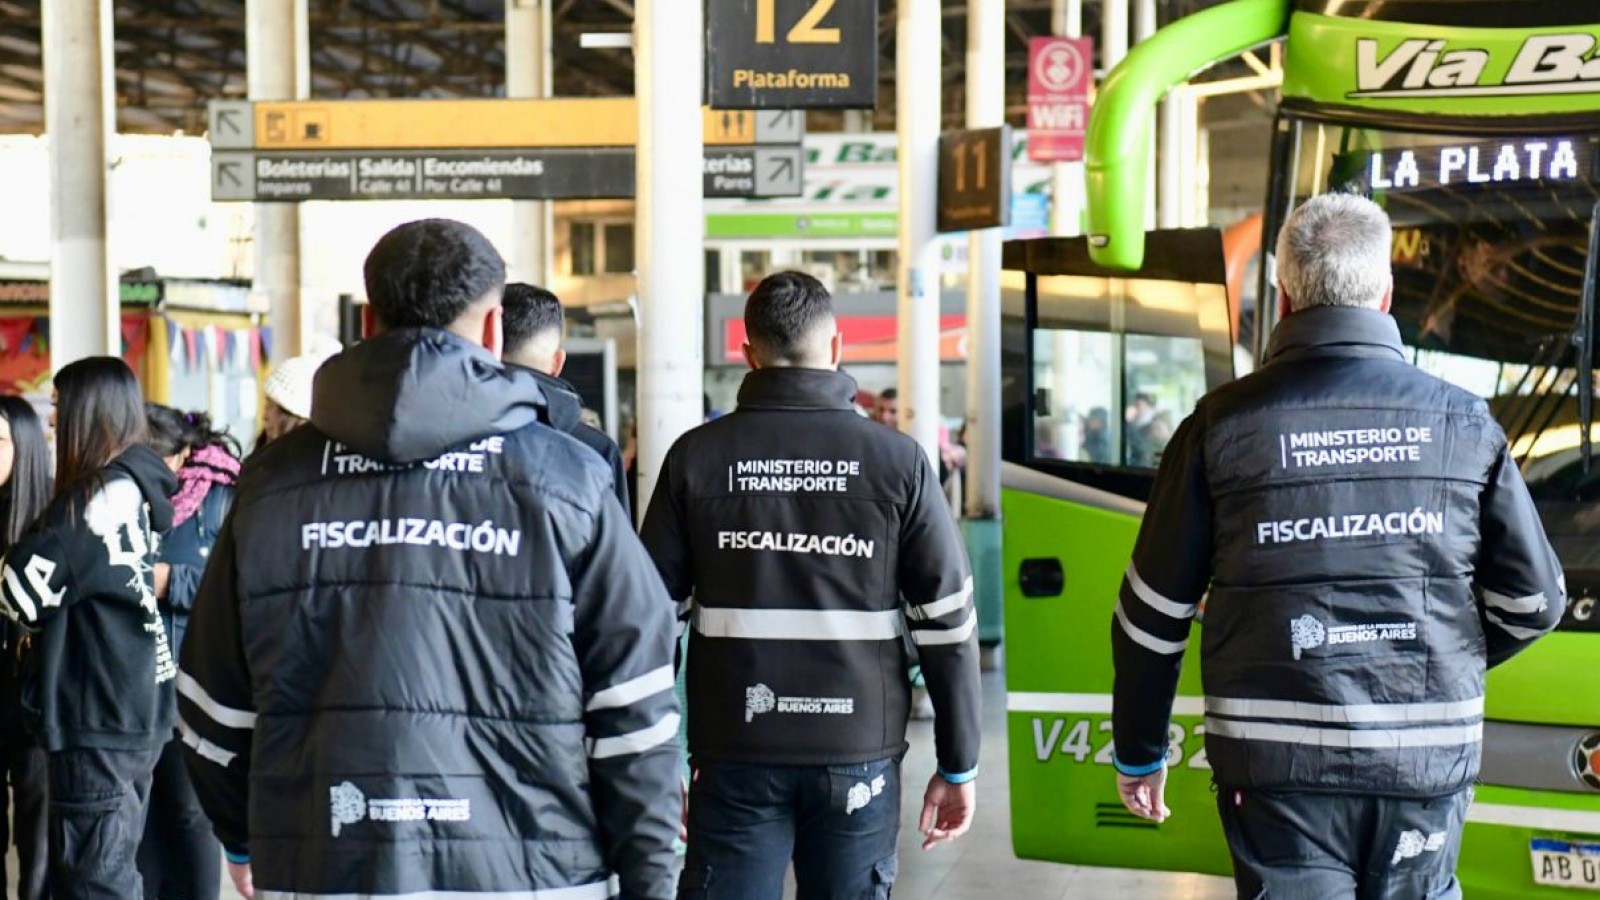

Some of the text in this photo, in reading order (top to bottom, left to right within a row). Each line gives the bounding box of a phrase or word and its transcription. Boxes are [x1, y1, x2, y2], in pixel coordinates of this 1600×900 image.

[1356, 37, 1490, 90] Via
[733, 69, 850, 88] Plataforma
[1032, 104, 1083, 129] WiFi
[257, 157, 544, 178] Boleterías Salida Encomiendas
[703, 153, 752, 172] terías
[952, 140, 986, 192] 11
[1371, 140, 1578, 188] LA PLATA
[713, 175, 752, 191] Pares
[1290, 426, 1432, 449] MINISTERIO DE
[737, 459, 860, 475] MINISTERIO DE
[1291, 445, 1420, 468] TRANSPORTE
[737, 476, 848, 492] TRANSPORTE
[302, 518, 521, 556] FISCALIZACIÓN
[1257, 507, 1443, 544] FISCALIZACIÓN
[718, 531, 875, 559] FISCALIZACIÓN
[1328, 628, 1417, 645] BUENOS AIRES
[777, 702, 854, 714] BUENOS AIRES
[1032, 718, 1213, 769] V4282
[369, 806, 470, 821] BUENOS AIRES
[1542, 855, 1600, 884] AB 0
